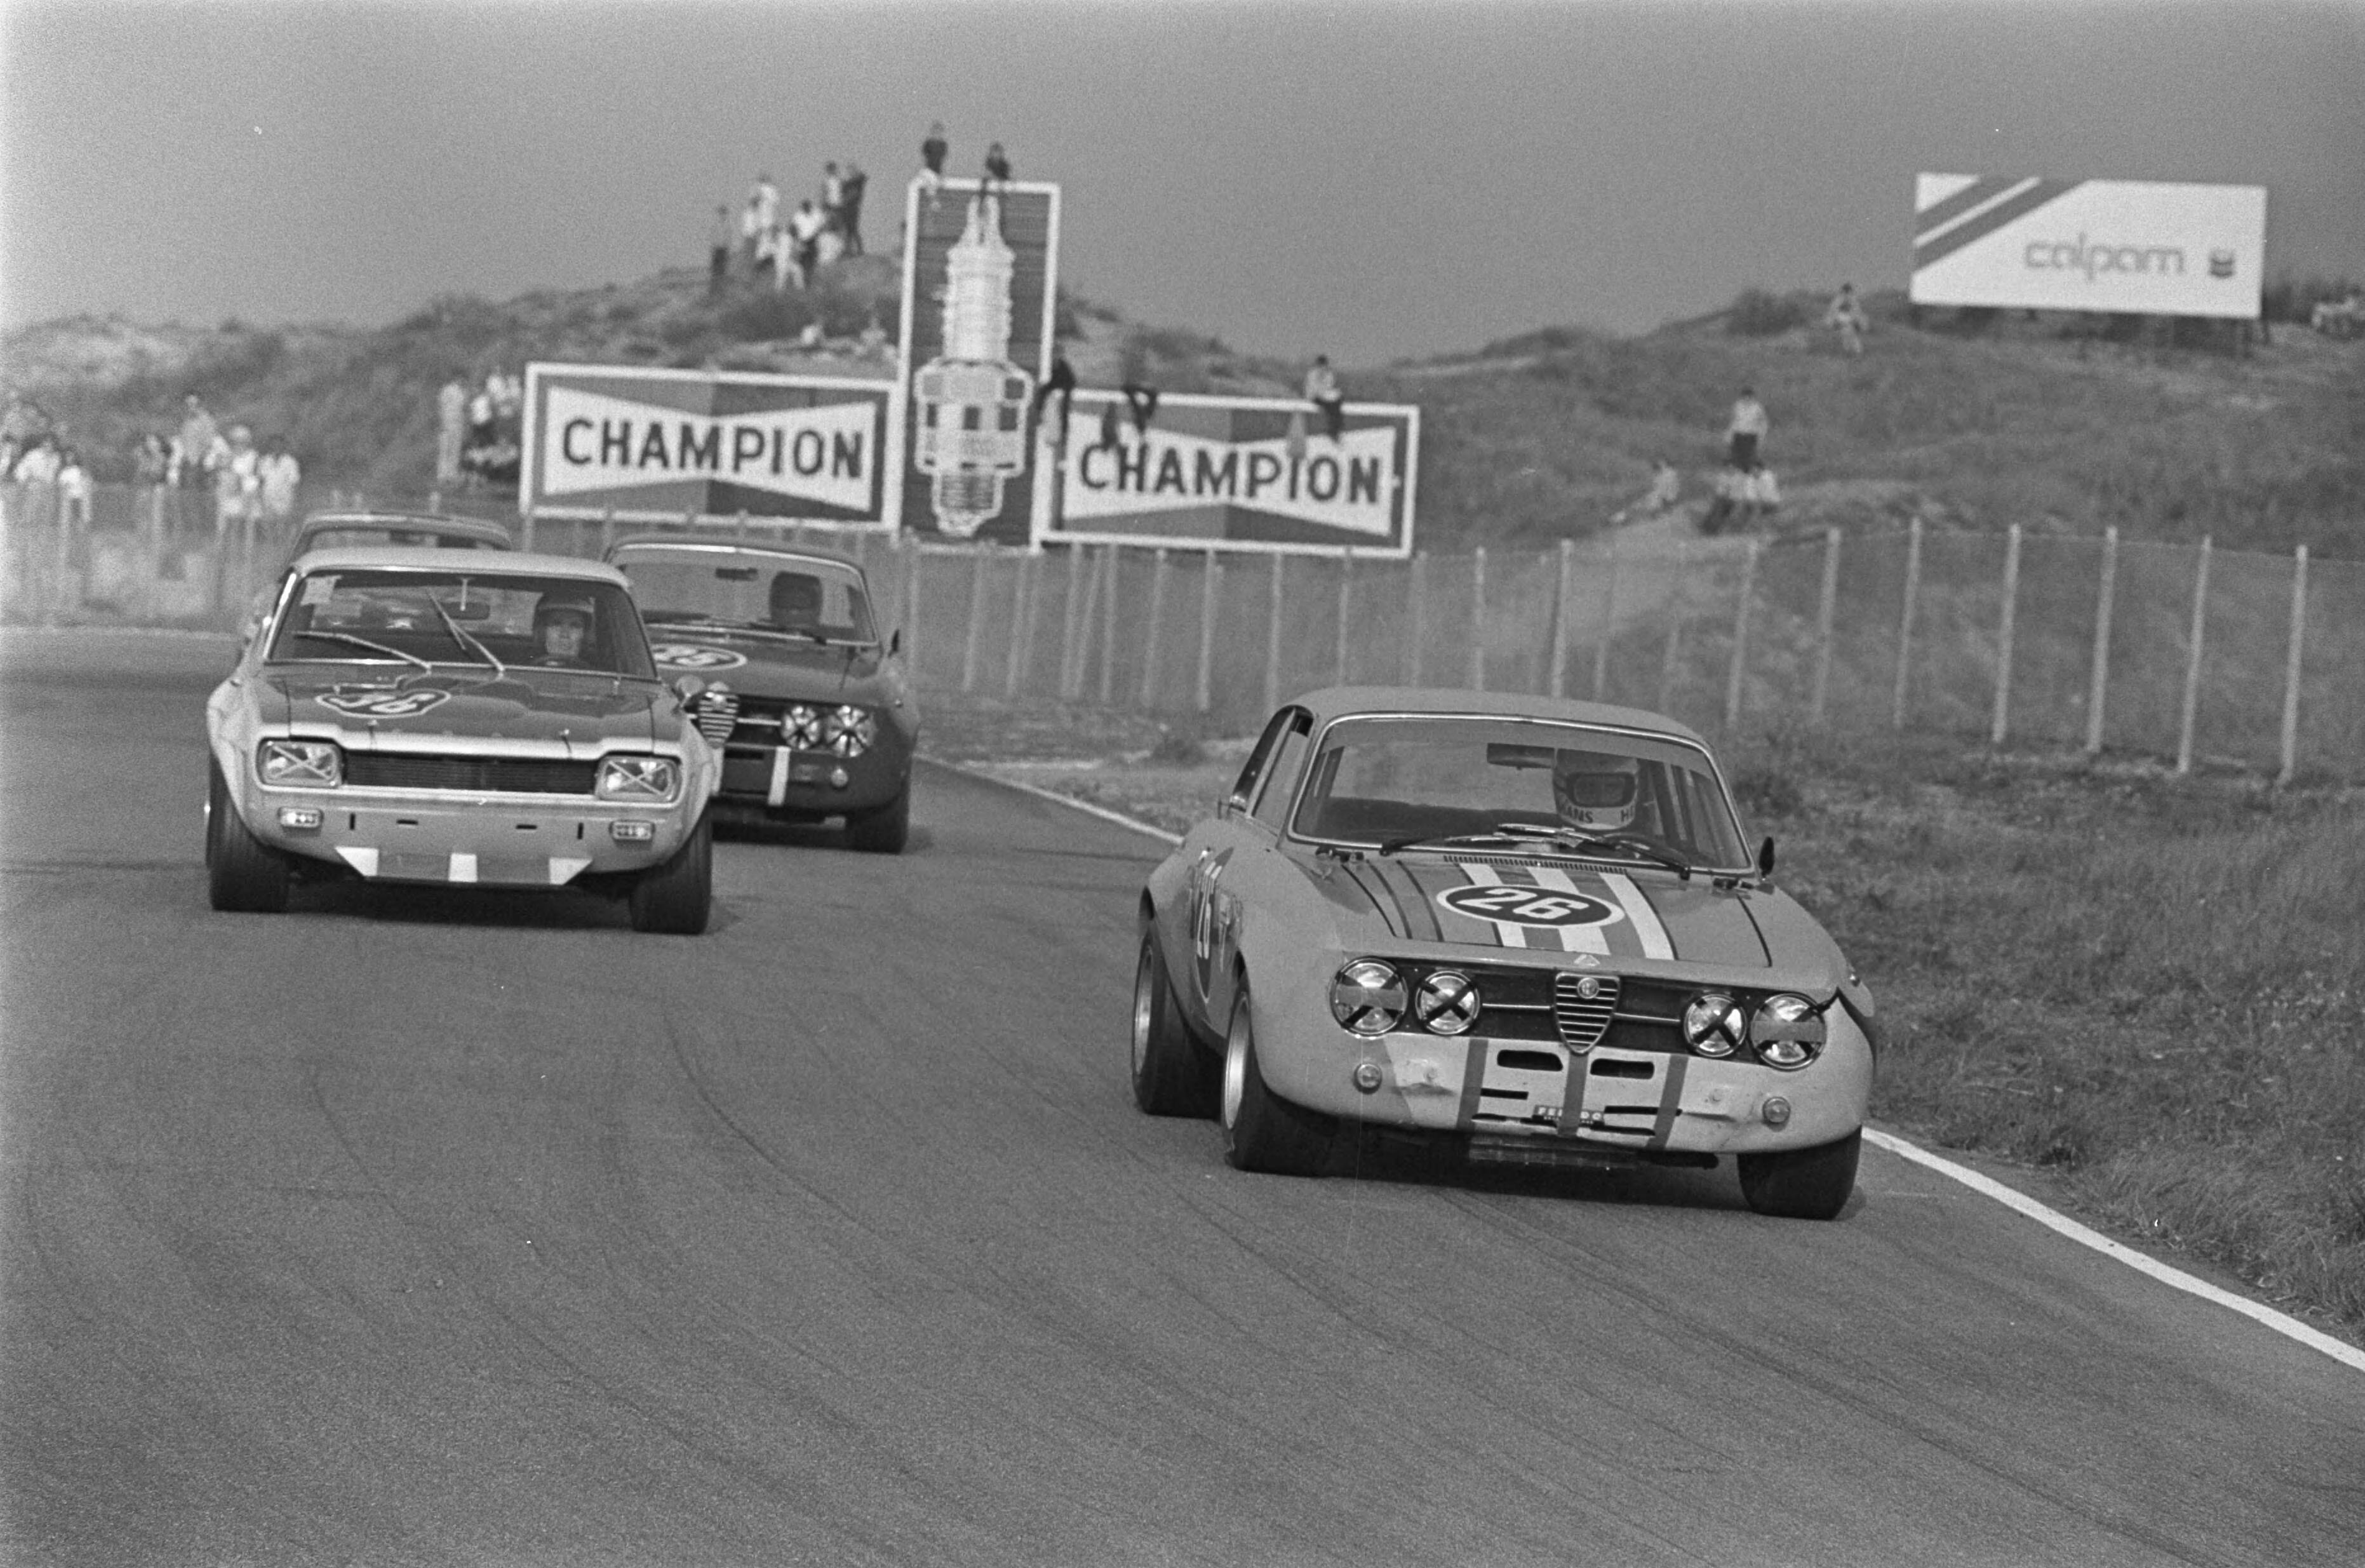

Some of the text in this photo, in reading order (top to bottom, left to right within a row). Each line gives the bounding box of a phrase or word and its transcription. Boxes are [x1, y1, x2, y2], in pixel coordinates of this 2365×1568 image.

[2025, 231, 2185, 280] calpam
[562, 417, 863, 478] CHAMPION
[1081, 445, 1379, 504] CHAMPION
[1456, 888, 1590, 920] 26
